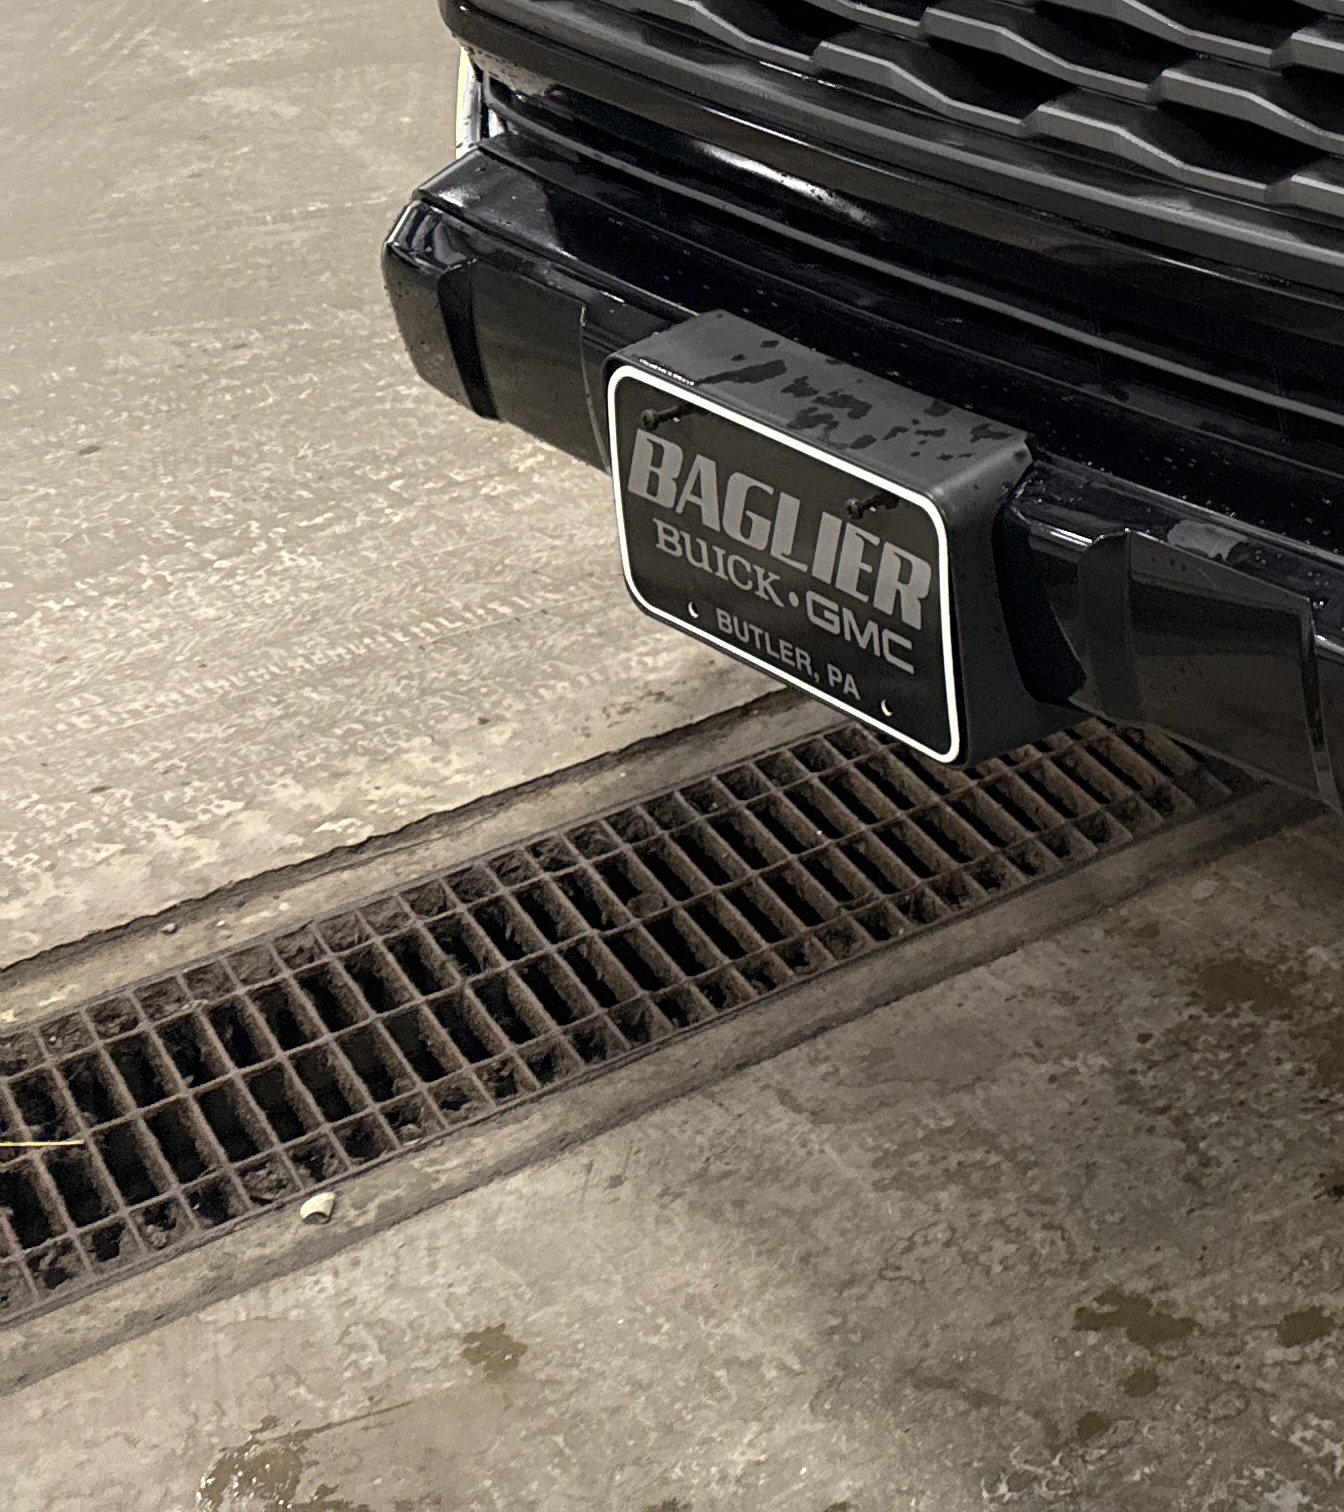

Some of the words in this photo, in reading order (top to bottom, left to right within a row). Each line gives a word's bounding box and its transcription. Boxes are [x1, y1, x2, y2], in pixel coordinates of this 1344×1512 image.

[628, 428, 932, 630] BAGLIER
[715, 608, 821, 683] BUTLER,
[827, 663, 861, 701] PA
